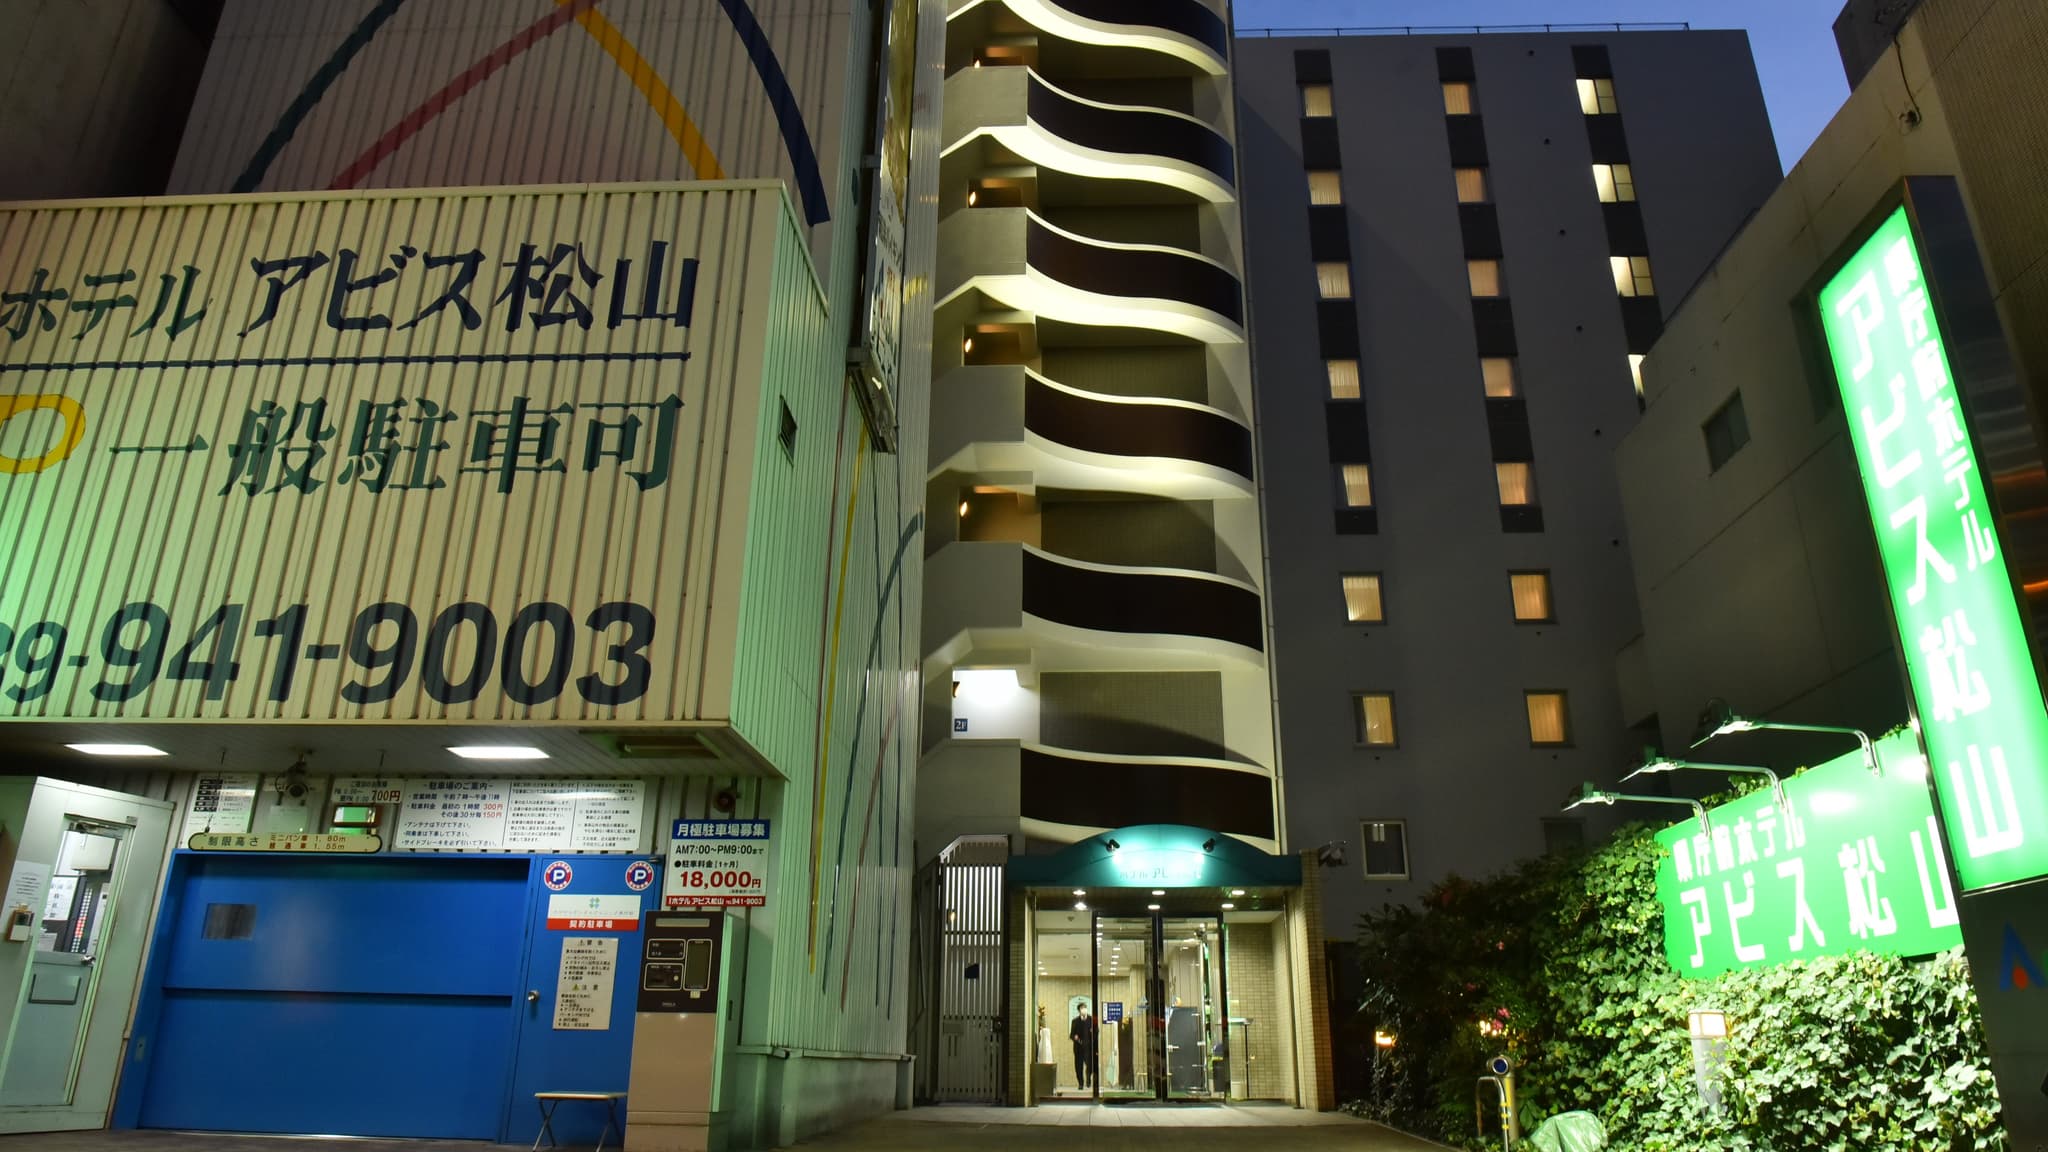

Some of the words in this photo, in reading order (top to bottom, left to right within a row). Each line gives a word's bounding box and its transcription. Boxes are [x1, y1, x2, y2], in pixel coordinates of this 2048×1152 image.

[0, 266, 208, 342] ホテル
[238, 240, 700, 338] アビス松山
[110, 394, 685, 498] 一般駐車可
[1836, 270, 2023, 858] アビス松山
[371, 790, 400, 801] 700円
[677, 823, 765, 836] 月極駐車場募集
[680, 871, 761, 889] 18,000円
